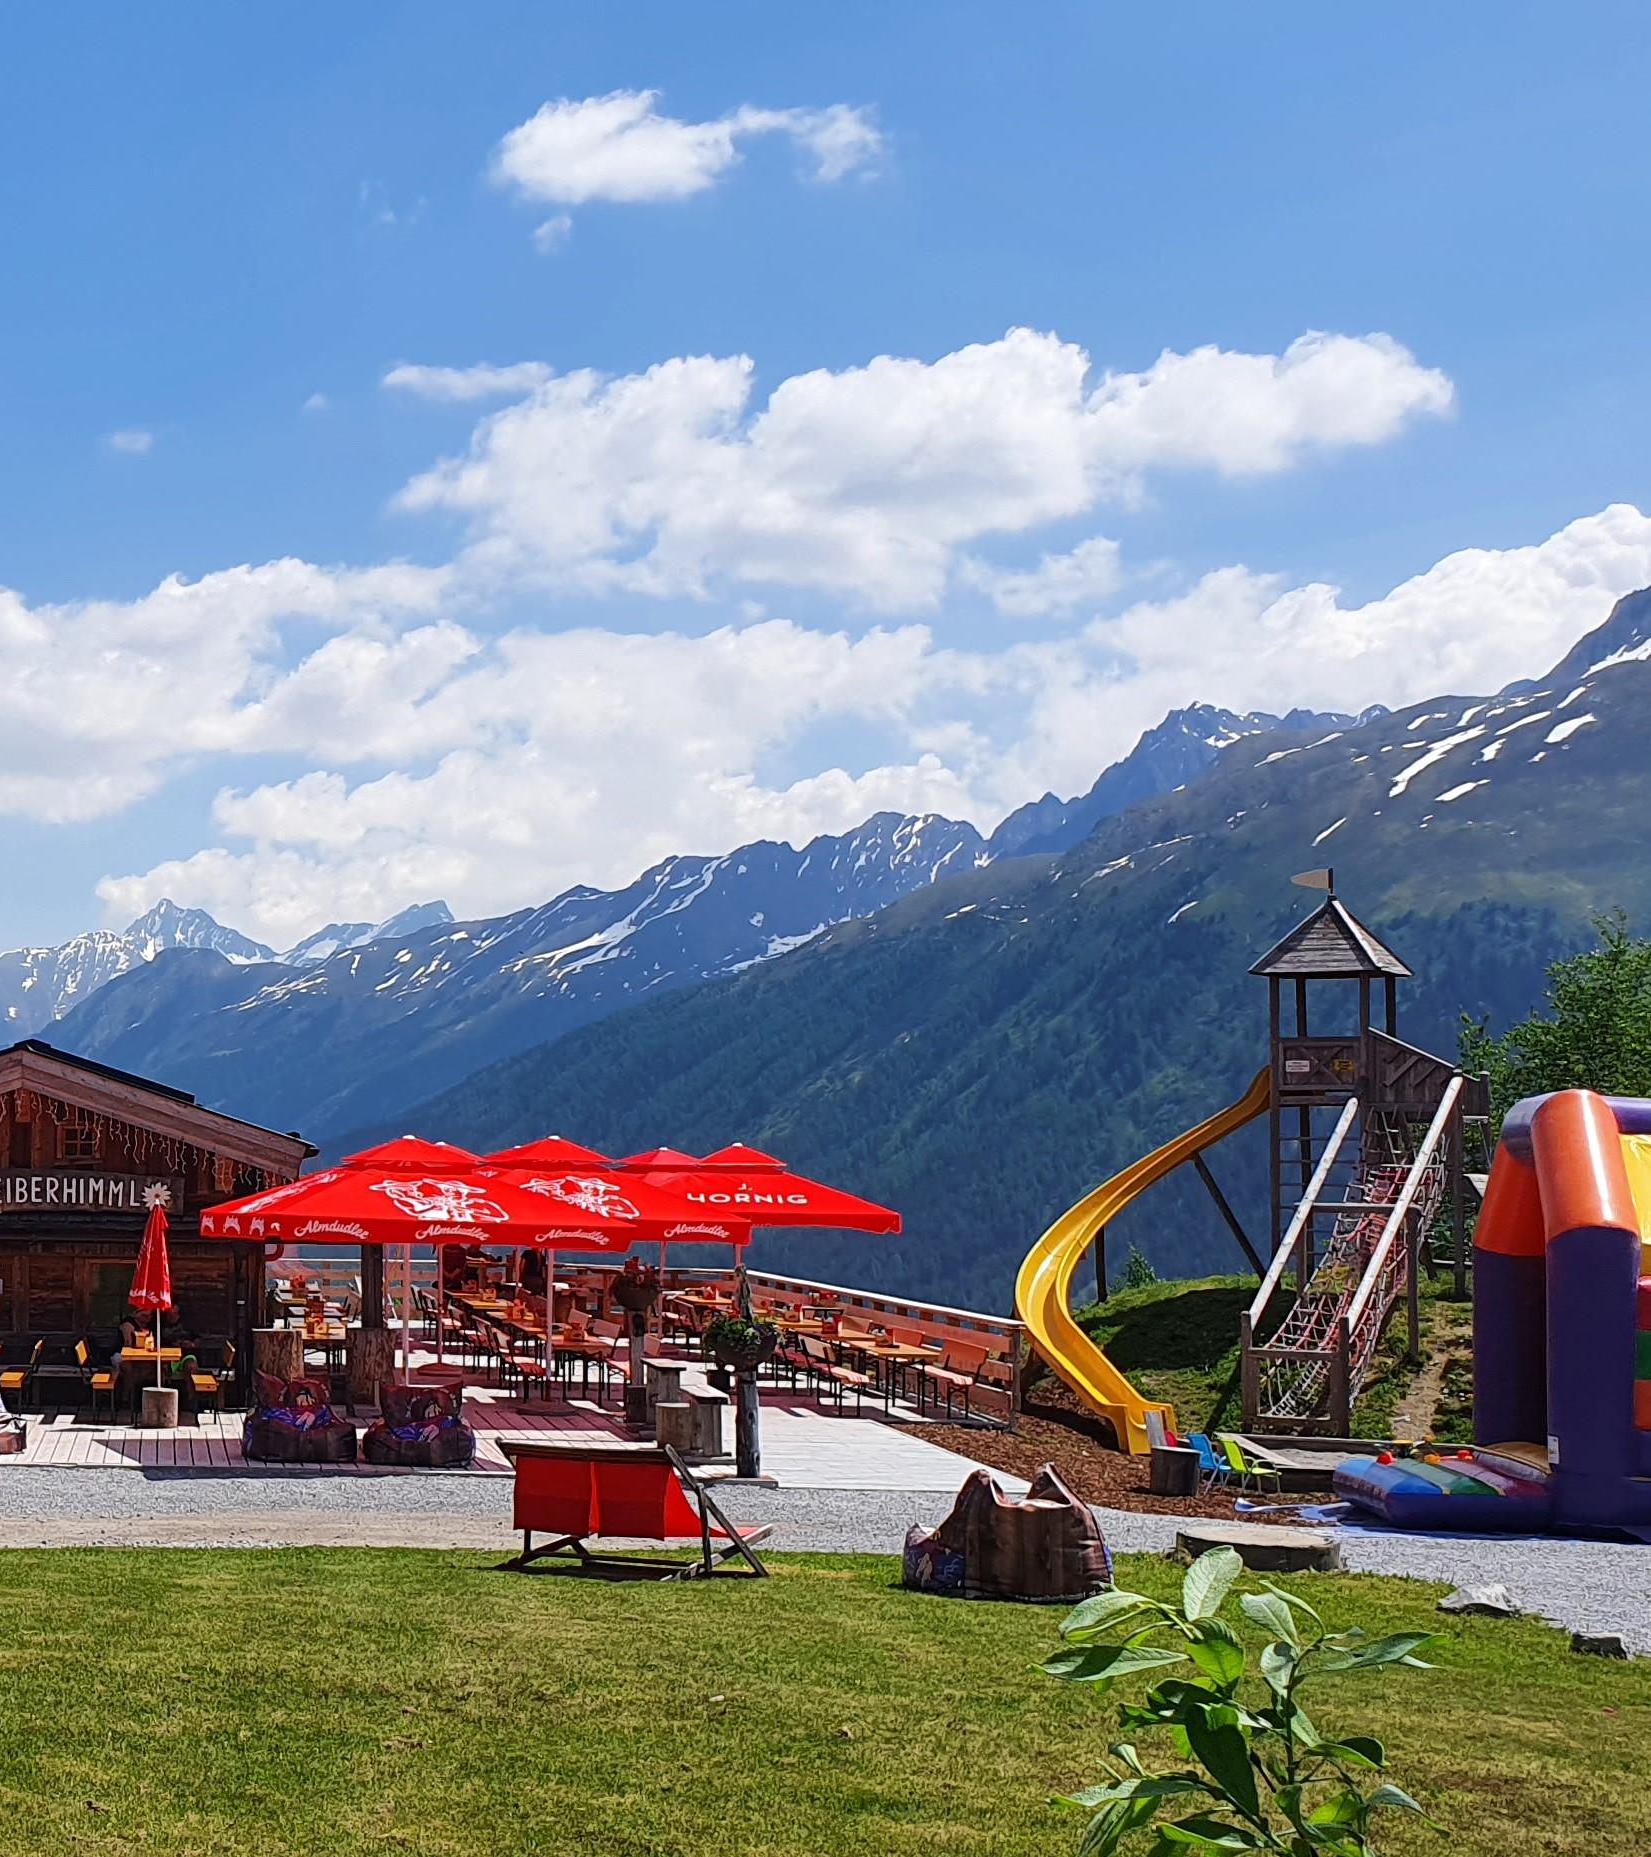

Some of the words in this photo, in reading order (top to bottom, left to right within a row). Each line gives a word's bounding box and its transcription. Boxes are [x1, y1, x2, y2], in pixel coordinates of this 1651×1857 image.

[294, 1219, 370, 1240] Almdudler
[415, 1223, 490, 1241] Almdudler
[534, 1228, 610, 1246] Almdudler
[663, 1223, 730, 1238] Almdudler
